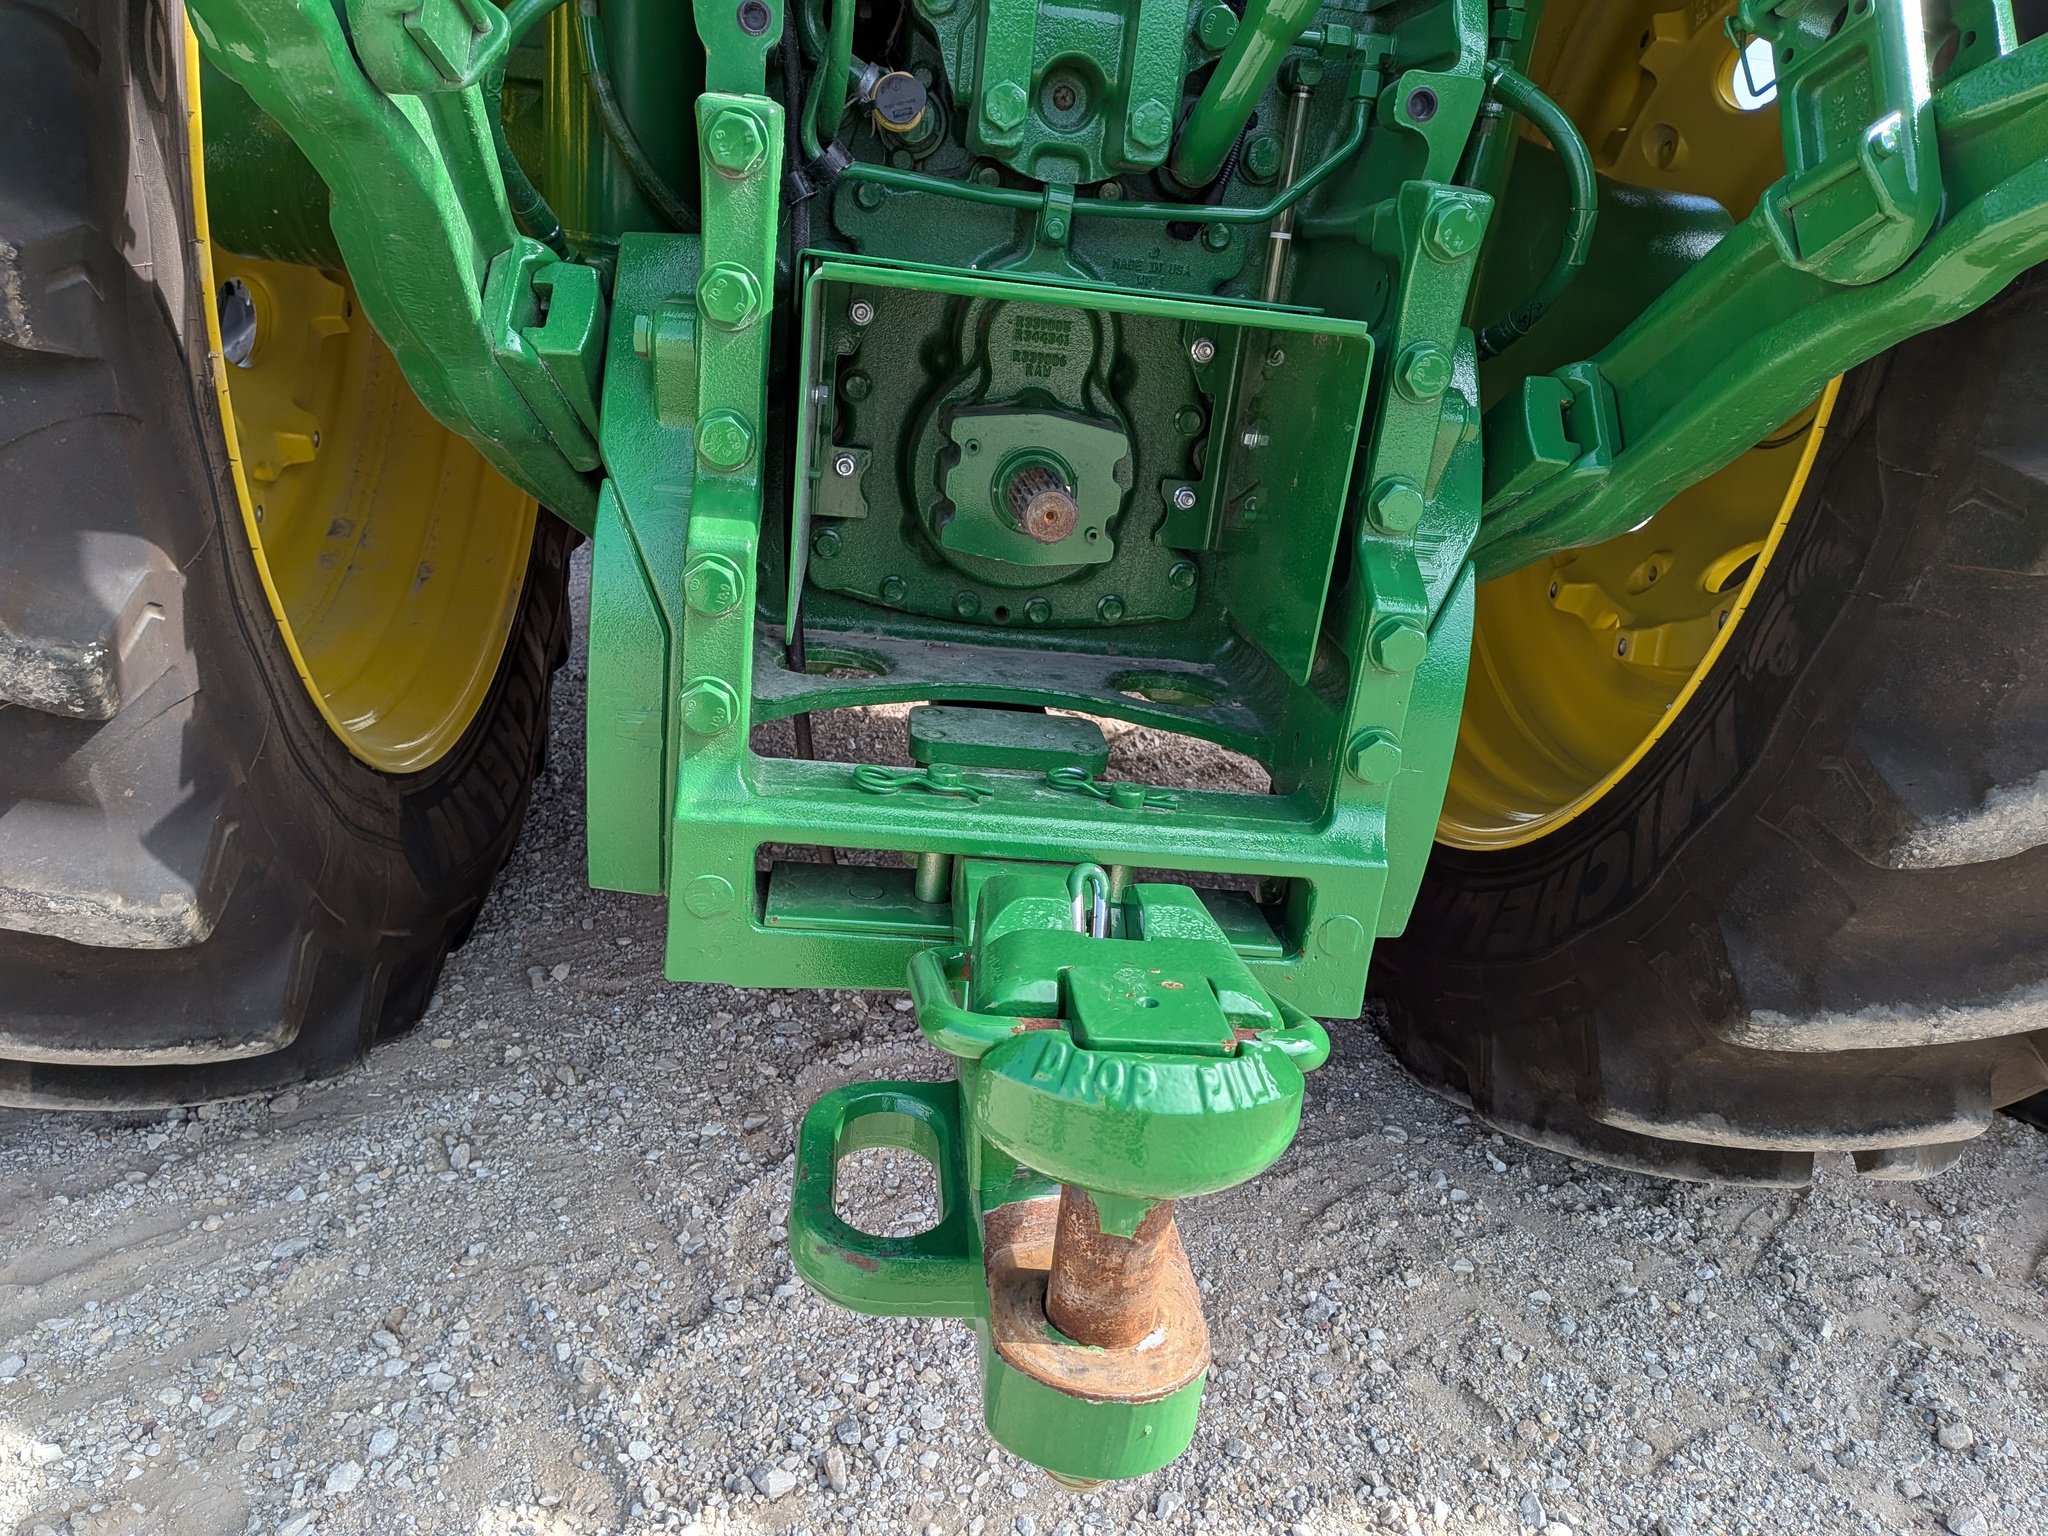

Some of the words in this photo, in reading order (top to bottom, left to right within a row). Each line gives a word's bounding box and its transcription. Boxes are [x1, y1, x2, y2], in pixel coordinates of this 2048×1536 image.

[1168, 262, 1191, 277] USA
[1025, 363, 1053, 378] RAW
[1032, 1039, 1158, 1110] DROP
[1196, 1051, 1284, 1114] PIN
